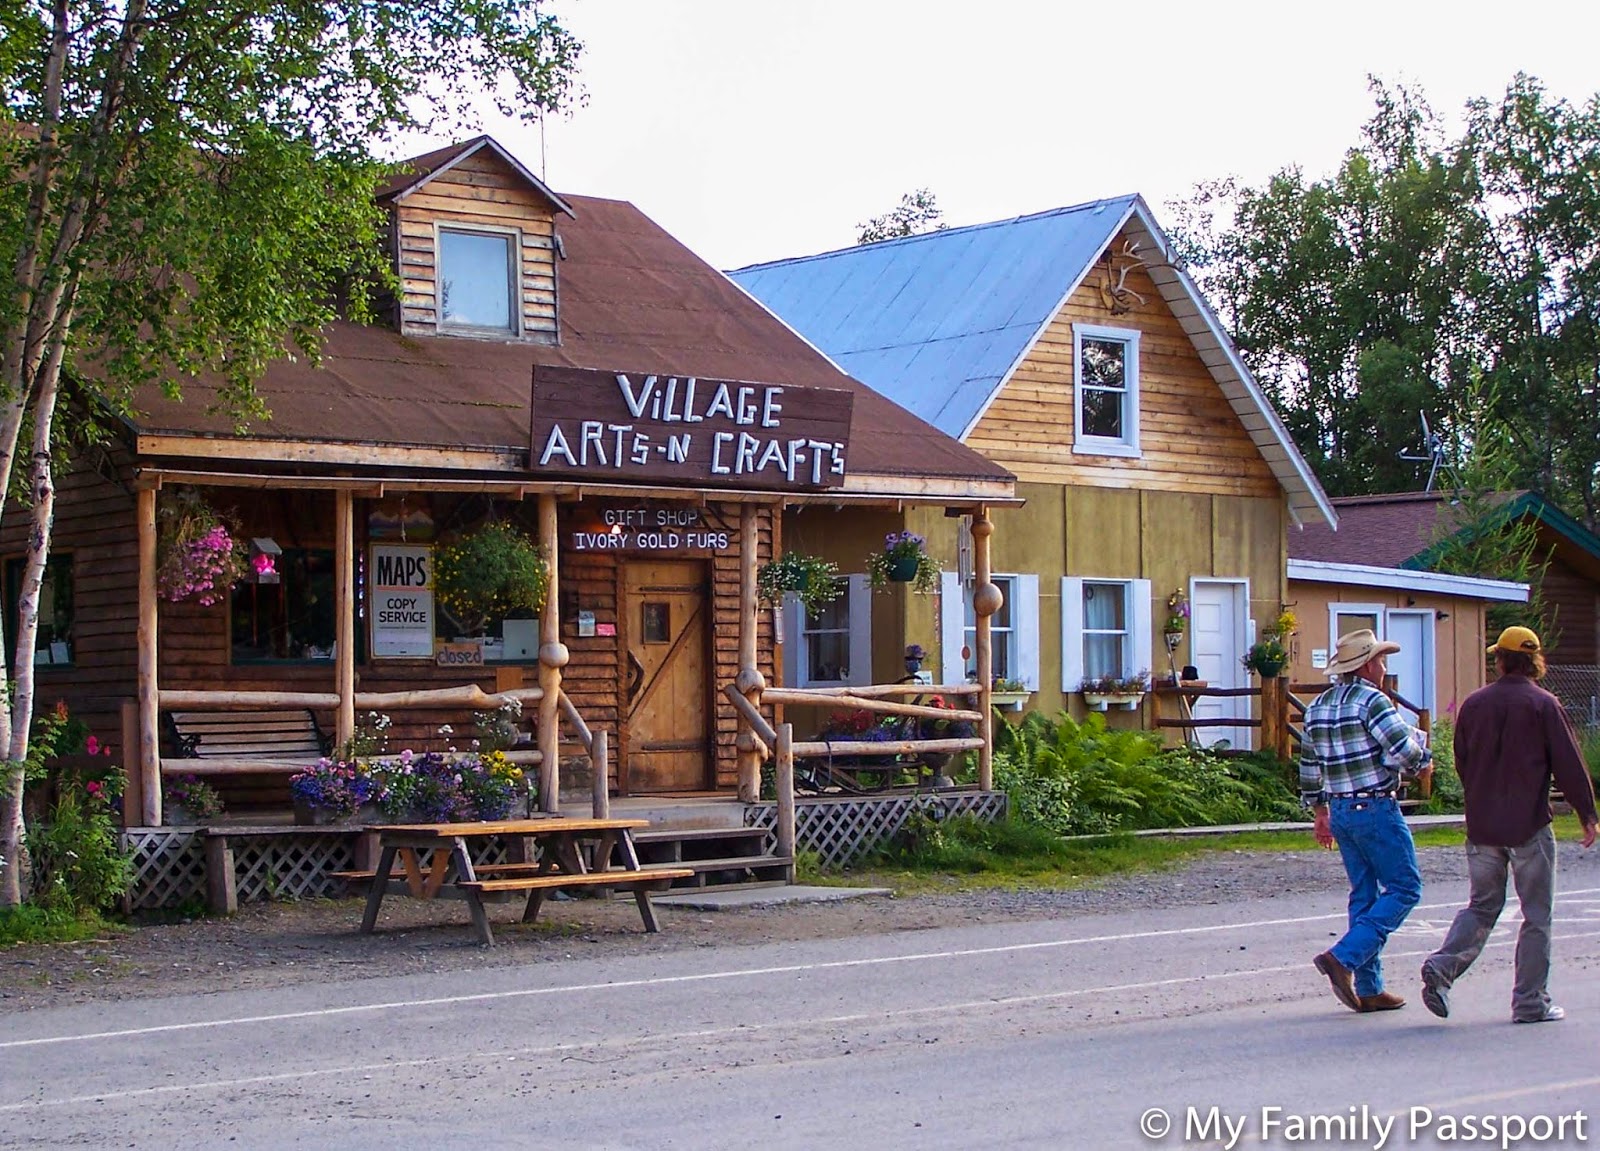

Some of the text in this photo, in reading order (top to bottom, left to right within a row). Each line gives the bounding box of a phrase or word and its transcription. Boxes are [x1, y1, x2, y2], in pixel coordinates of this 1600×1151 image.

[605, 509, 698, 526] GIFT SHOP
[575, 532, 728, 549] IVORY GOLD FURS
[377, 556, 426, 587] MAPS
[386, 598, 417, 610] COPY
[379, 611, 427, 623] SERVICE
